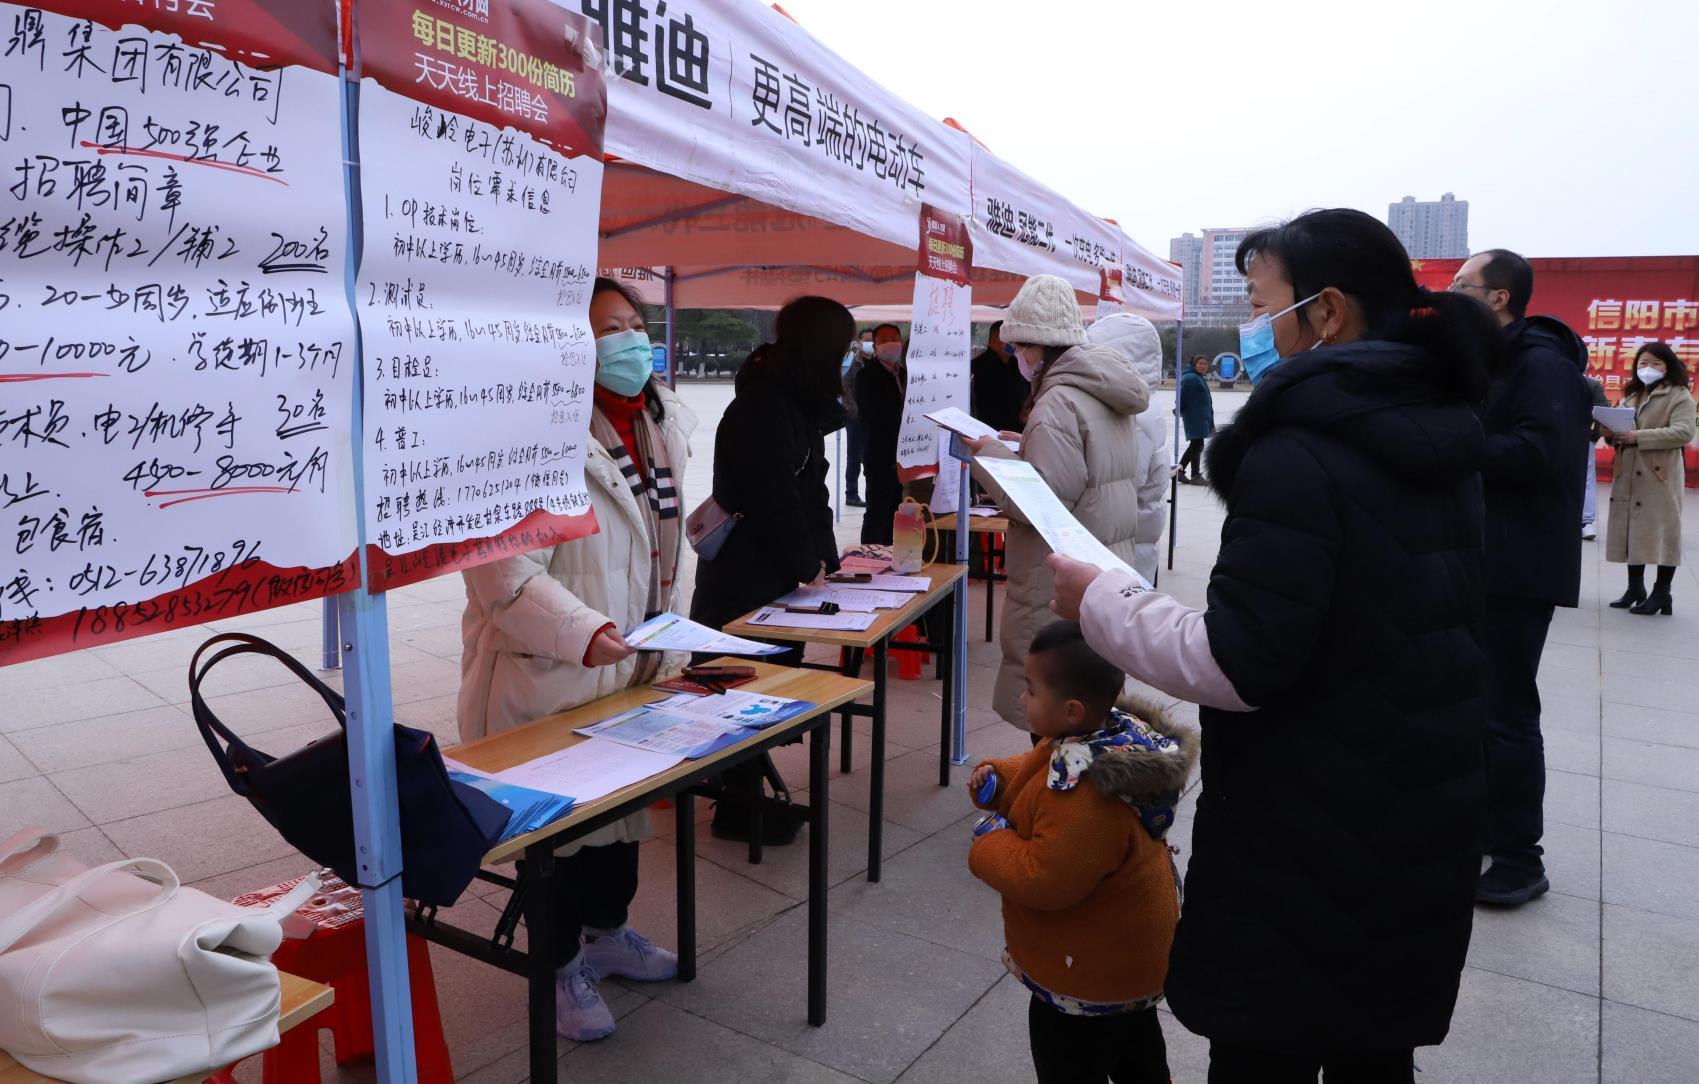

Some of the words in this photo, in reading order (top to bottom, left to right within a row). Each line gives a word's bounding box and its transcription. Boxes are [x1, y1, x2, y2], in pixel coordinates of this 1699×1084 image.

[411, 9, 576, 98] 每日更新300份简历
[414, 52, 548, 125] 天天线上招聘会
[62, 102, 285, 173] 中国500强企业
[749, 53, 925, 198] 更高端的电动车
[10, 155, 183, 235] 招聘简章
[450, 161, 551, 214] 岗位需求信息
[259, 227, 330, 270] 200名
[1587, 299, 1699, 331] 信阳市
[69, 540, 262, 597] 0512-63871896
